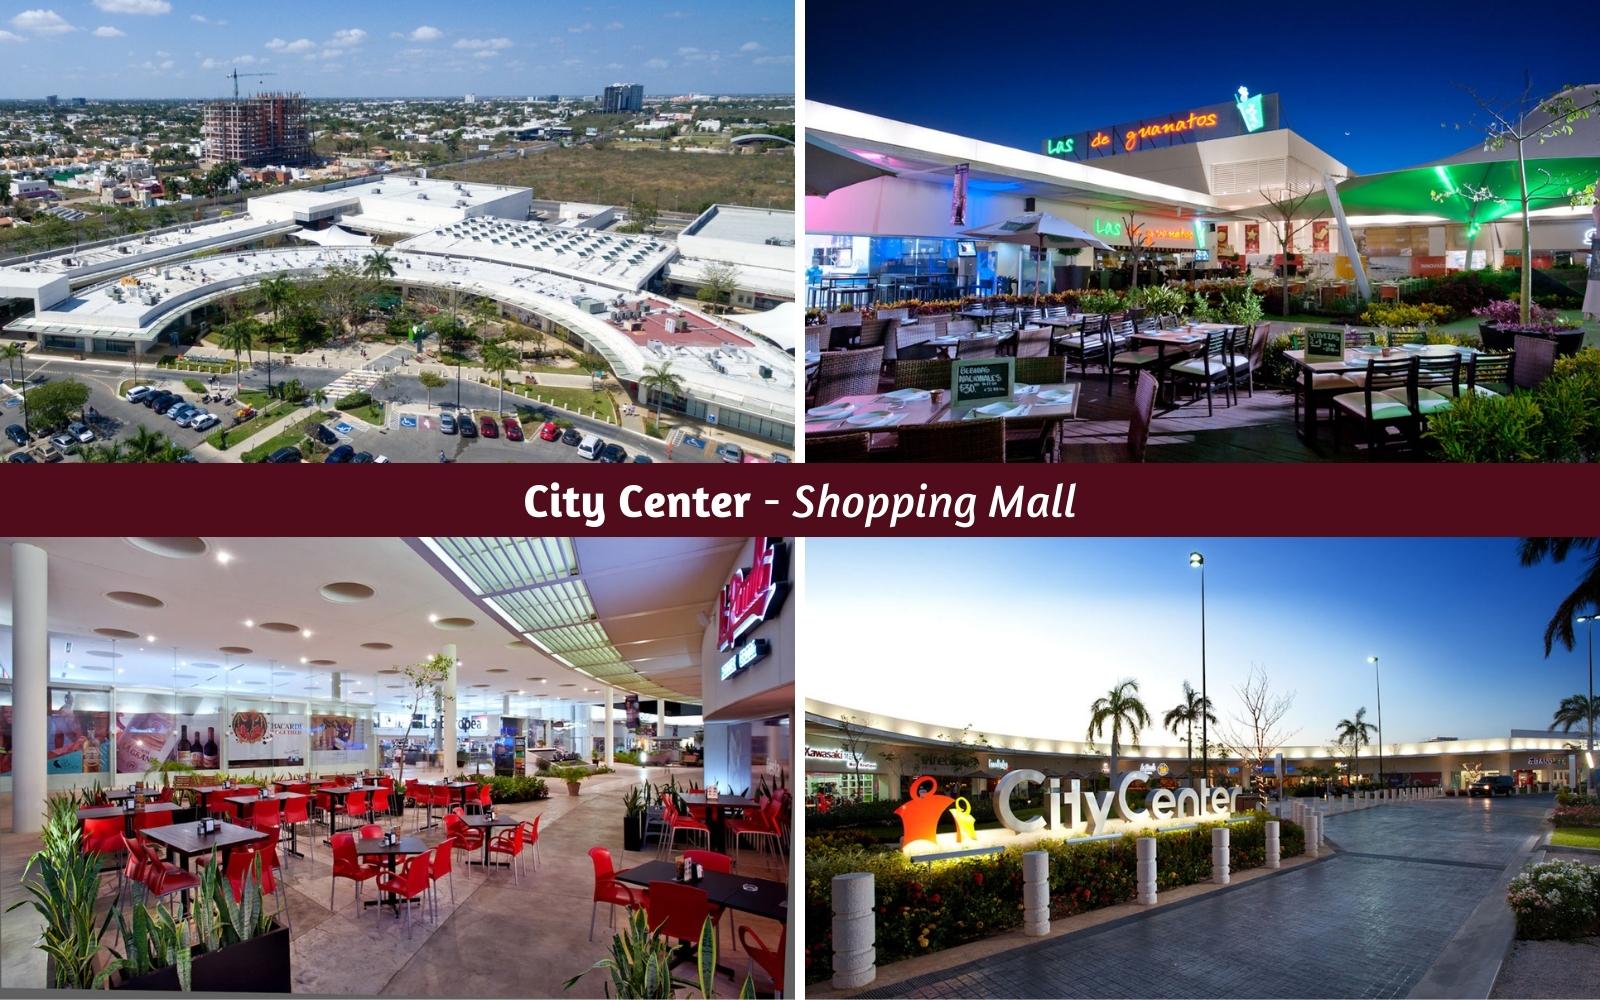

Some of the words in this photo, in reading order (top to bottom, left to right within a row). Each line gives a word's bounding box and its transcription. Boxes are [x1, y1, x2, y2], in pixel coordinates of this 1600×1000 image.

[1047, 138, 1075, 155] Las
[1090, 131, 1111, 148] de
[1125, 111, 1218, 151] guanatos
[1094, 218, 1121, 236] Las
[805, 746, 843, 760] Kawasaki
